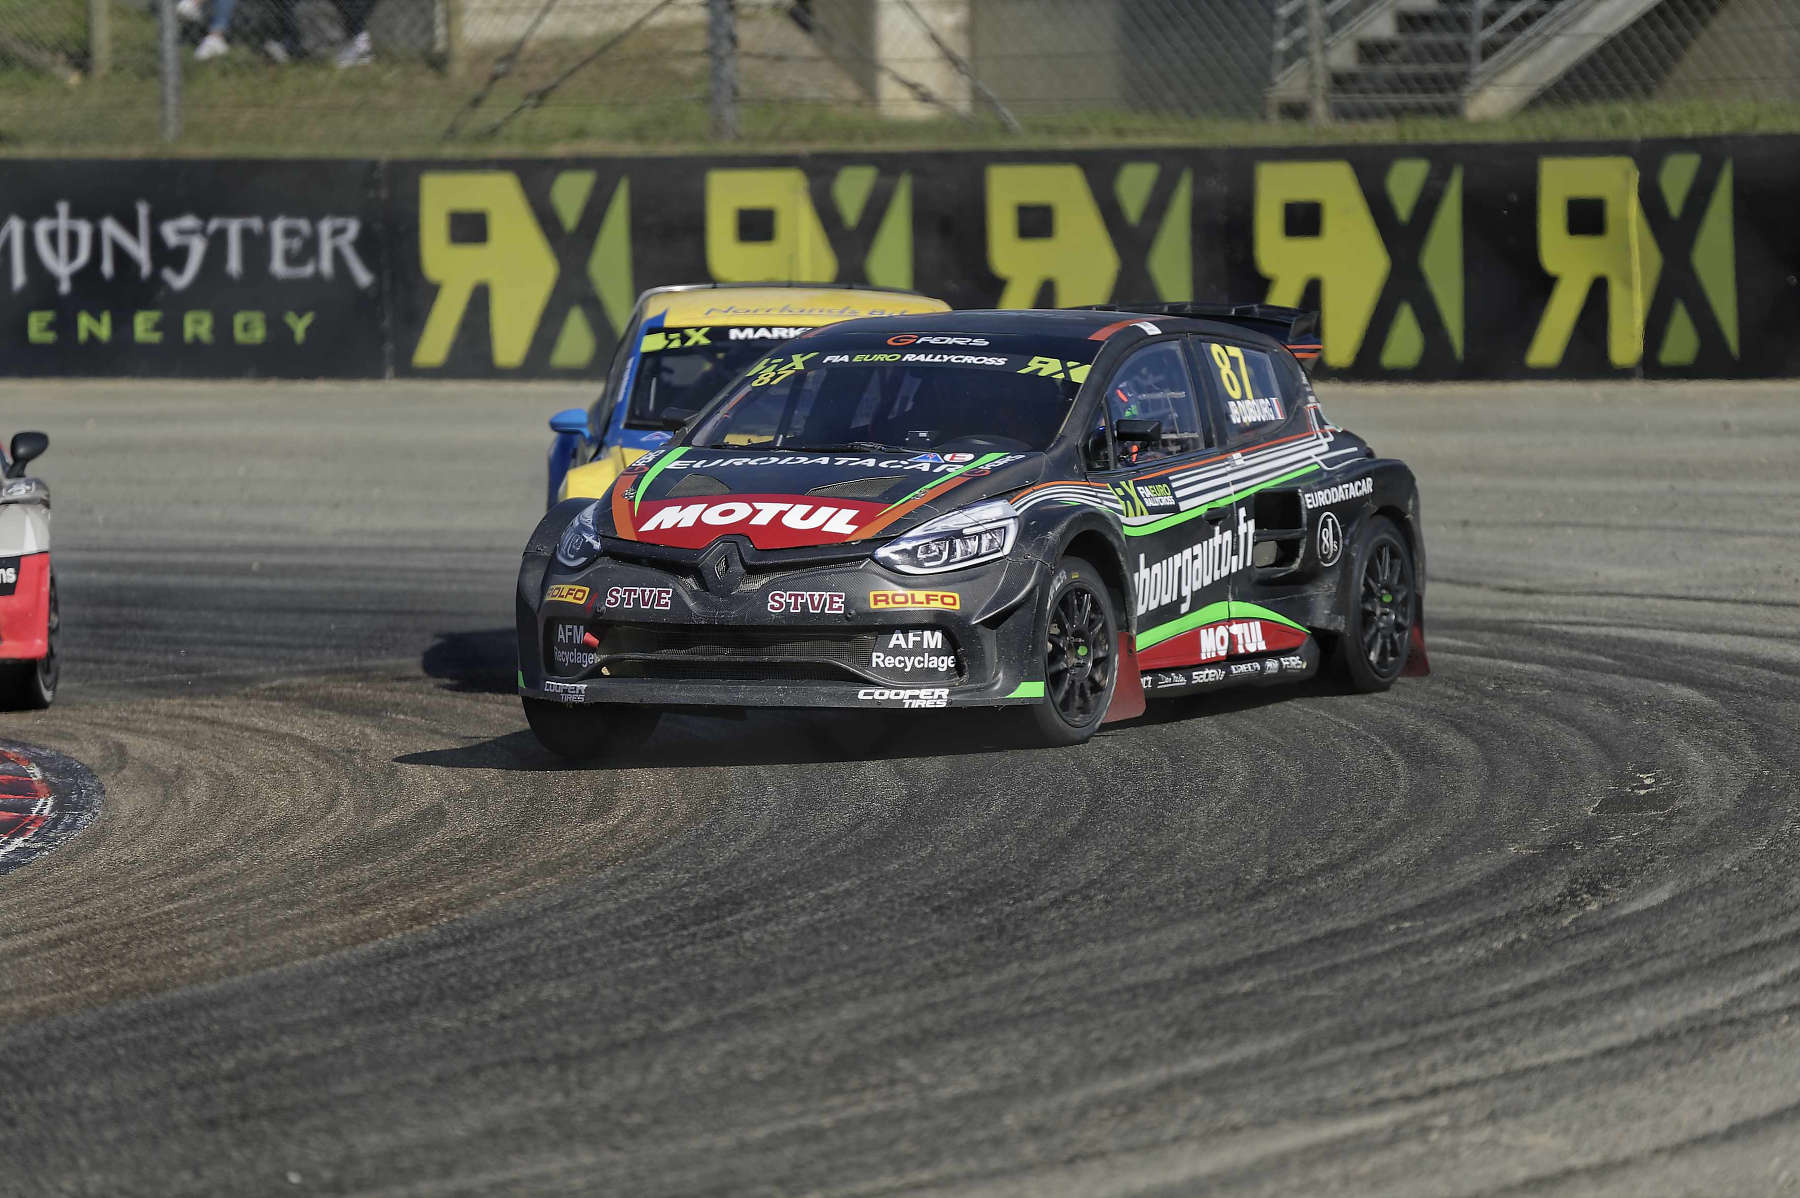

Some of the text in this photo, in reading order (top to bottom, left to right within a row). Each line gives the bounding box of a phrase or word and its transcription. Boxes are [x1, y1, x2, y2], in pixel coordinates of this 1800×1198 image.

[27, 309, 315, 345] ENERGY
[822, 352, 1009, 366] FIA EURO RALLYCROSS
[751, 369, 797, 387] 87
[1210, 343, 1254, 401] 87
[664, 455, 964, 473] EURODATACAR
[1148, 483, 1172, 497] EURO
[1305, 477, 1374, 509] EURODATACAR
[638, 502, 860, 535] MOTUL
[605, 586, 673, 610] STVE
[768, 591, 845, 614] STVE
[872, 592, 958, 607] ROLFO
[557, 624, 585, 644] AFM
[888, 630, 943, 649] AFM
[1200, 620, 1267, 660] MOTUL
[872, 652, 956, 672] Recyclage
[544, 681, 588, 693] COOPER
[857, 688, 950, 700] COOPER
[560, 693, 585, 703] TIRES
[902, 700, 948, 709] TIRES
